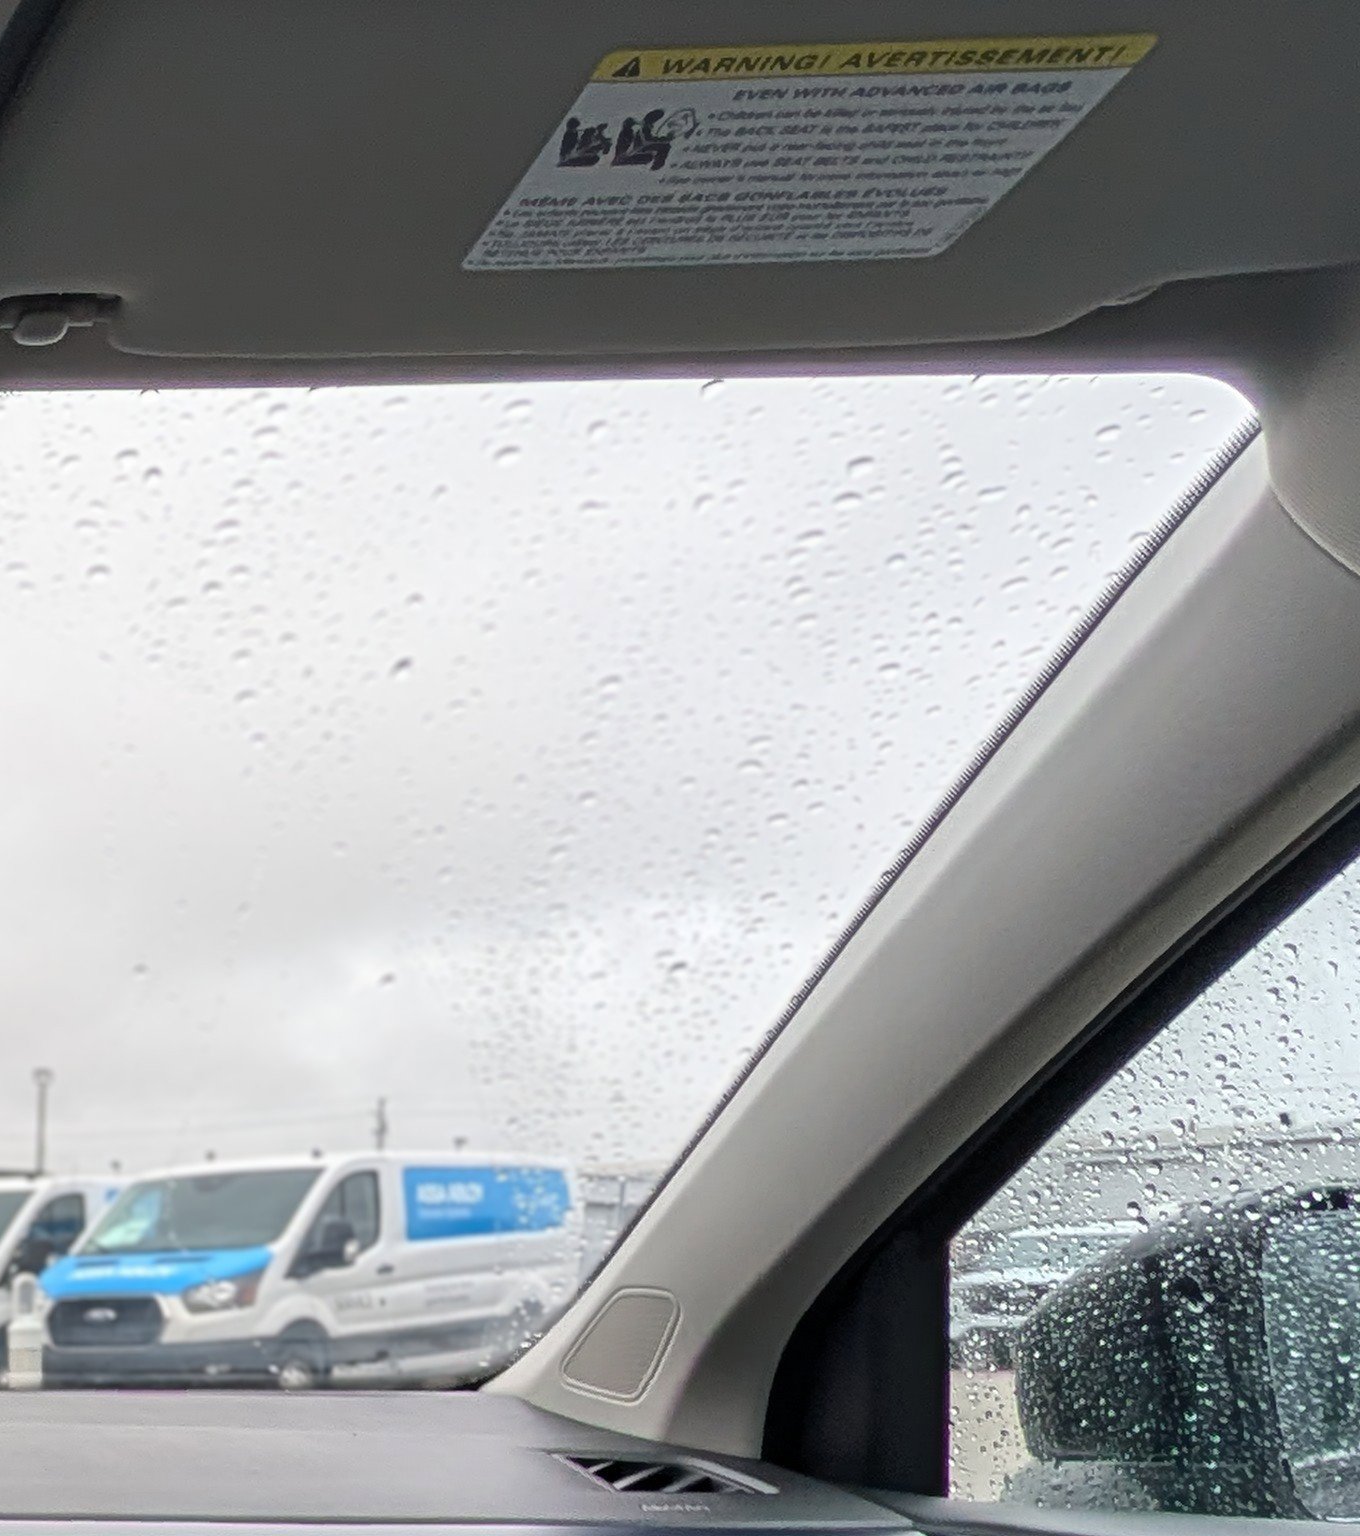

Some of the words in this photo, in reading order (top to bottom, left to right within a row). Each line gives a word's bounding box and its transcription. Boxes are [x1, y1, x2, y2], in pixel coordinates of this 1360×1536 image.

[662, 53, 832, 75] WARNING!
[840, 45, 1125, 69] AVERTISSEMENT!
[732, 87, 788, 101] EVEN
[793, 86, 849, 99] WITH
[850, 83, 964, 98] ADVANCED
[967, 82, 1008, 95] AIR
[1010, 80, 1073, 95] BAGS
